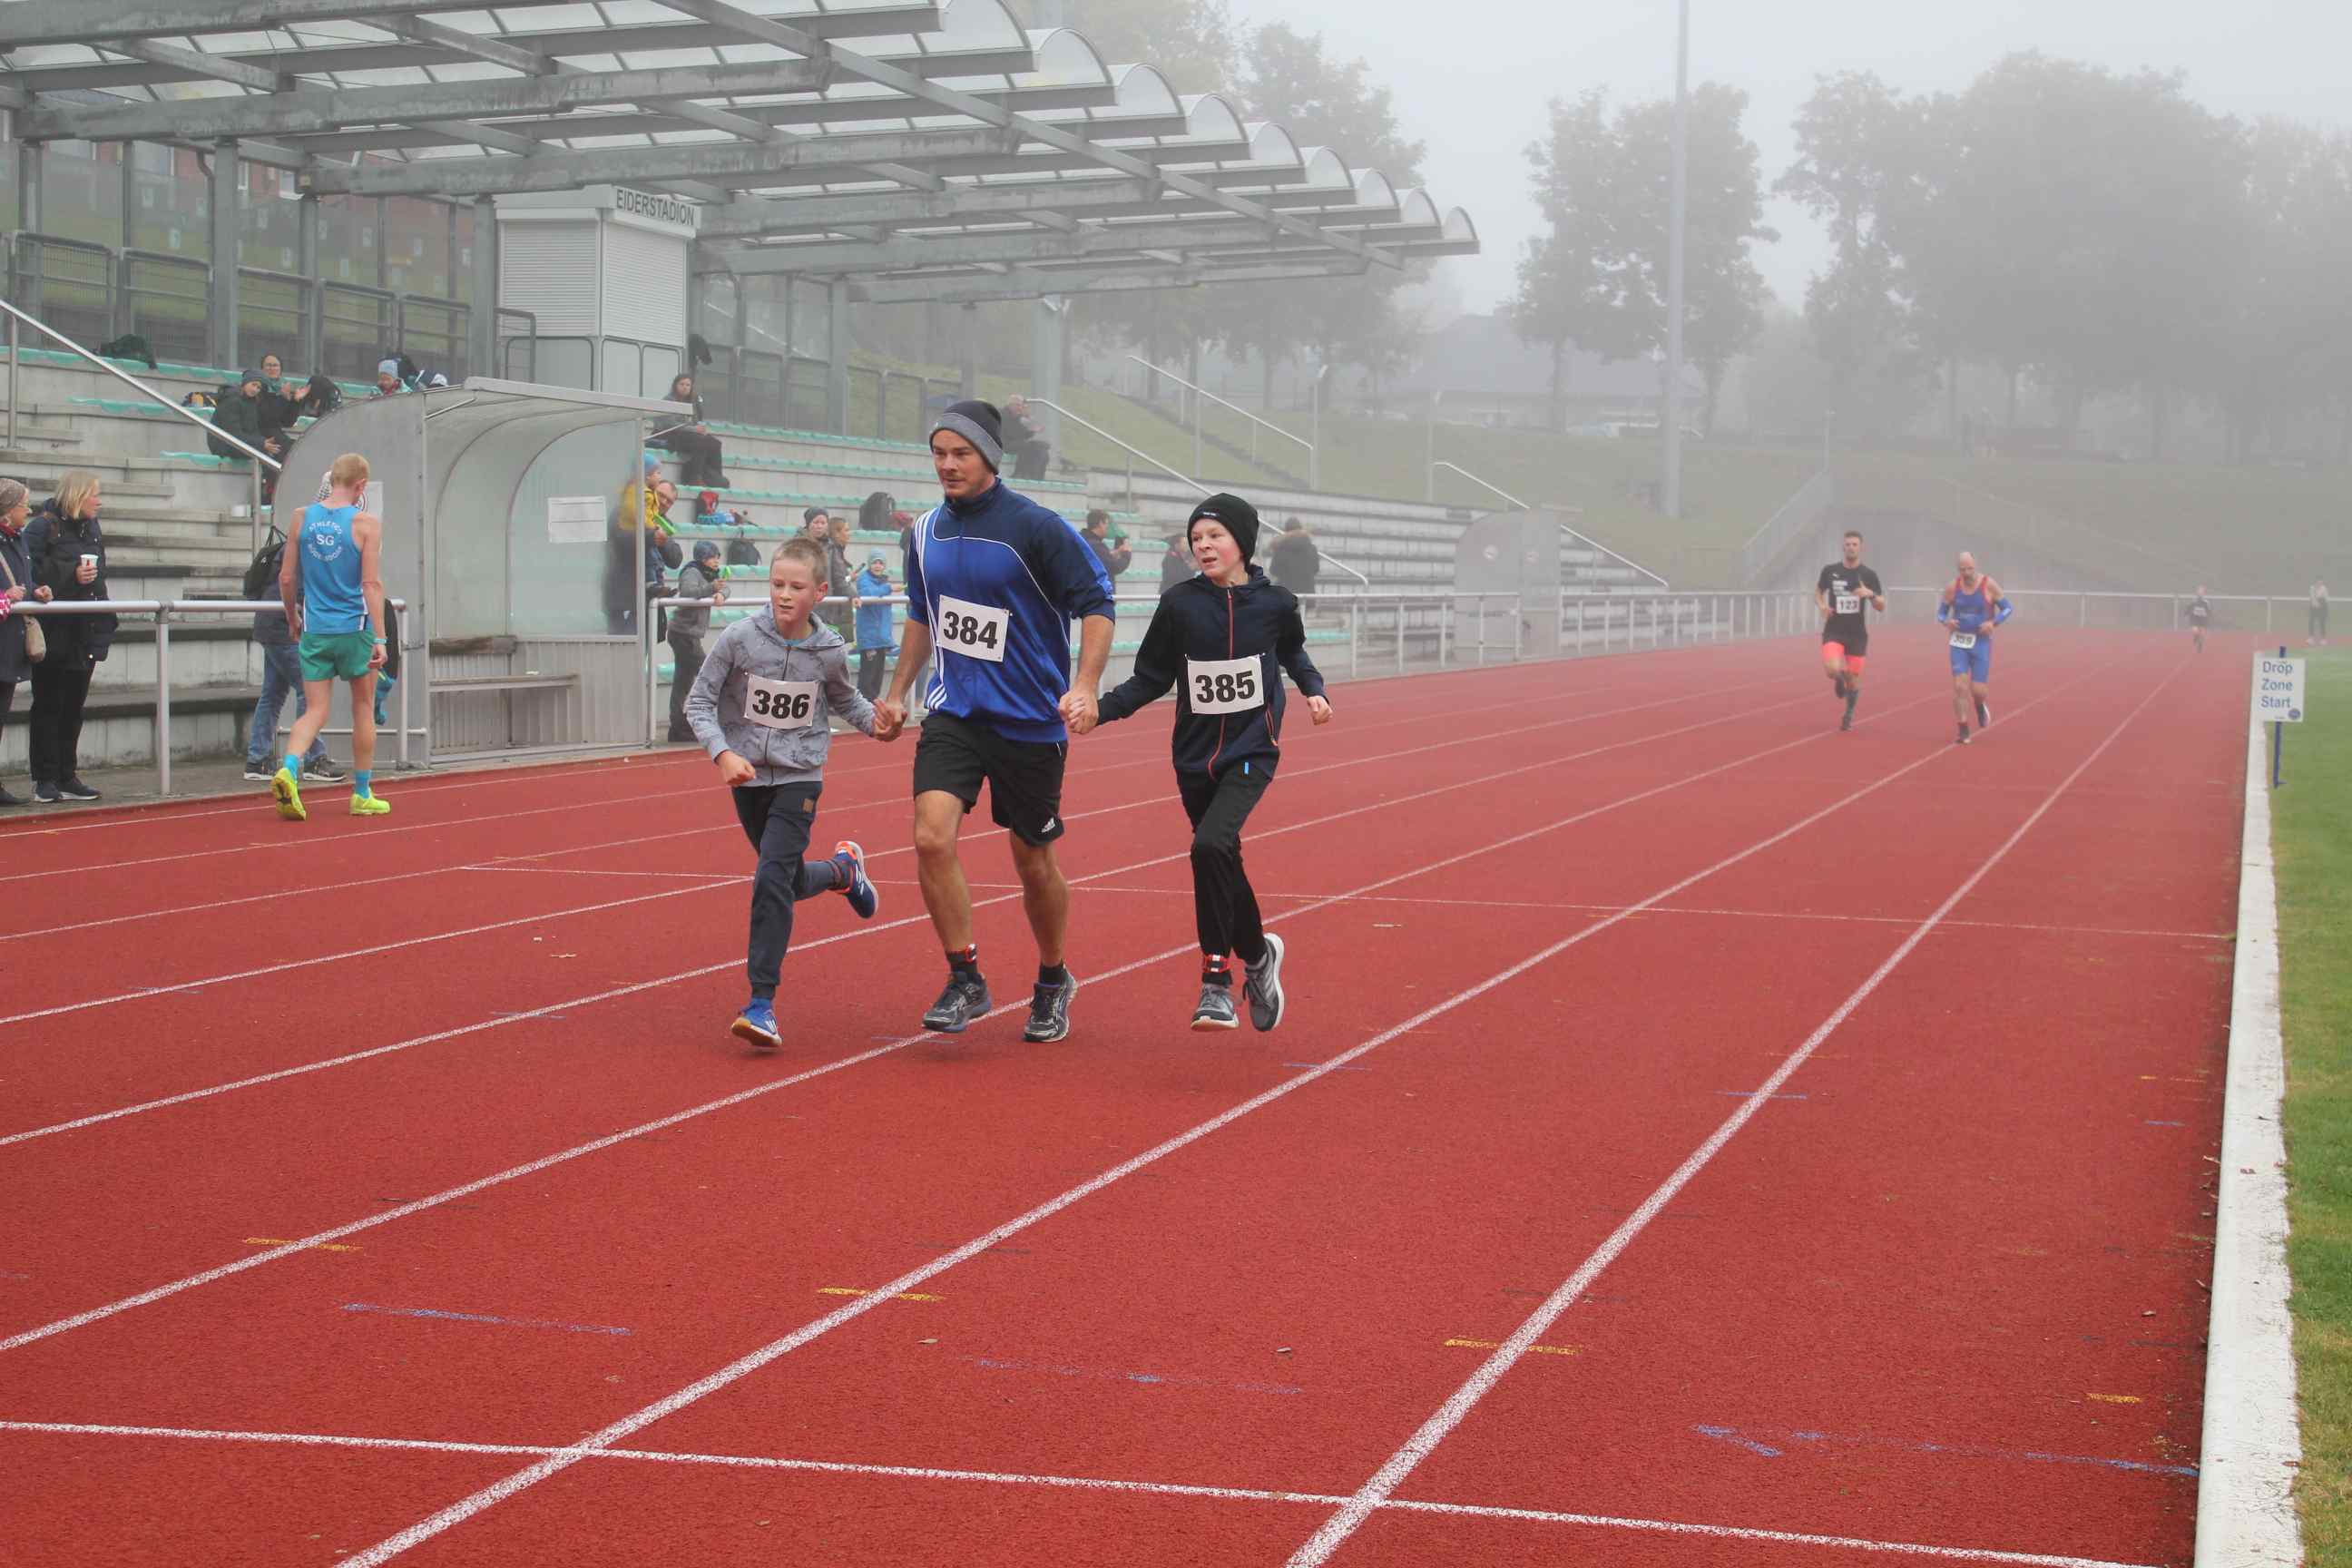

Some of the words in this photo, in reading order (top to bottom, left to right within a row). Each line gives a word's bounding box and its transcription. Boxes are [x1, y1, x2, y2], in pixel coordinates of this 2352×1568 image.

[616, 188, 695, 226] EIDERSTADION
[316, 534, 335, 546] SG
[943, 611, 998, 650] 384
[2262, 661, 2293, 676] Drop
[1195, 670, 1255, 704] 385
[2261, 678, 2293, 691] Zone
[752, 689, 811, 720] 386
[2260, 695, 2291, 709] Start
